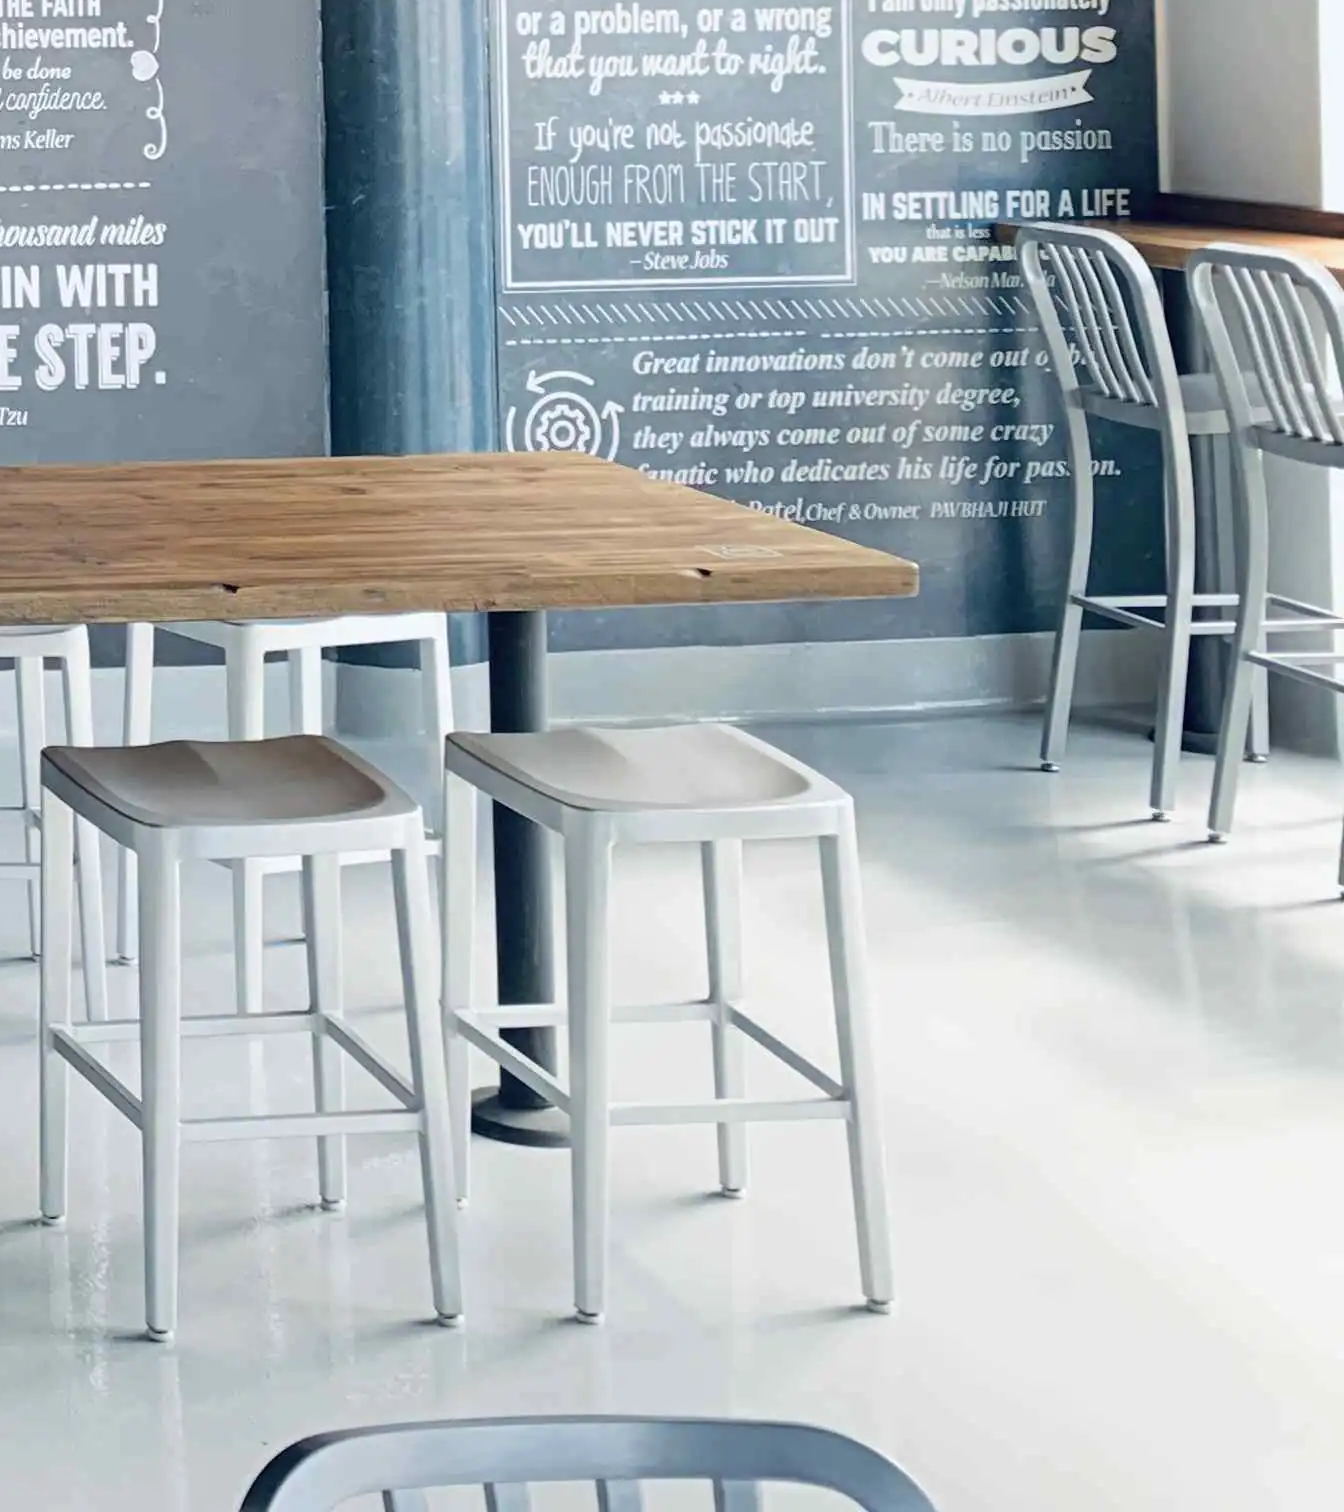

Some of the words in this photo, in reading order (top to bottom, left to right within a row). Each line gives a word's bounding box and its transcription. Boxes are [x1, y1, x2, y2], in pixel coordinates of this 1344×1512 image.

[861, 25, 1118, 67] CURIOUS
[55, 263, 158, 308] WITH
[631, 386, 730, 417] training
[734, 392, 764, 410] or
[767, 389, 806, 415] top
[811, 382, 931, 412] university
[936, 385, 1021, 414] degree,
